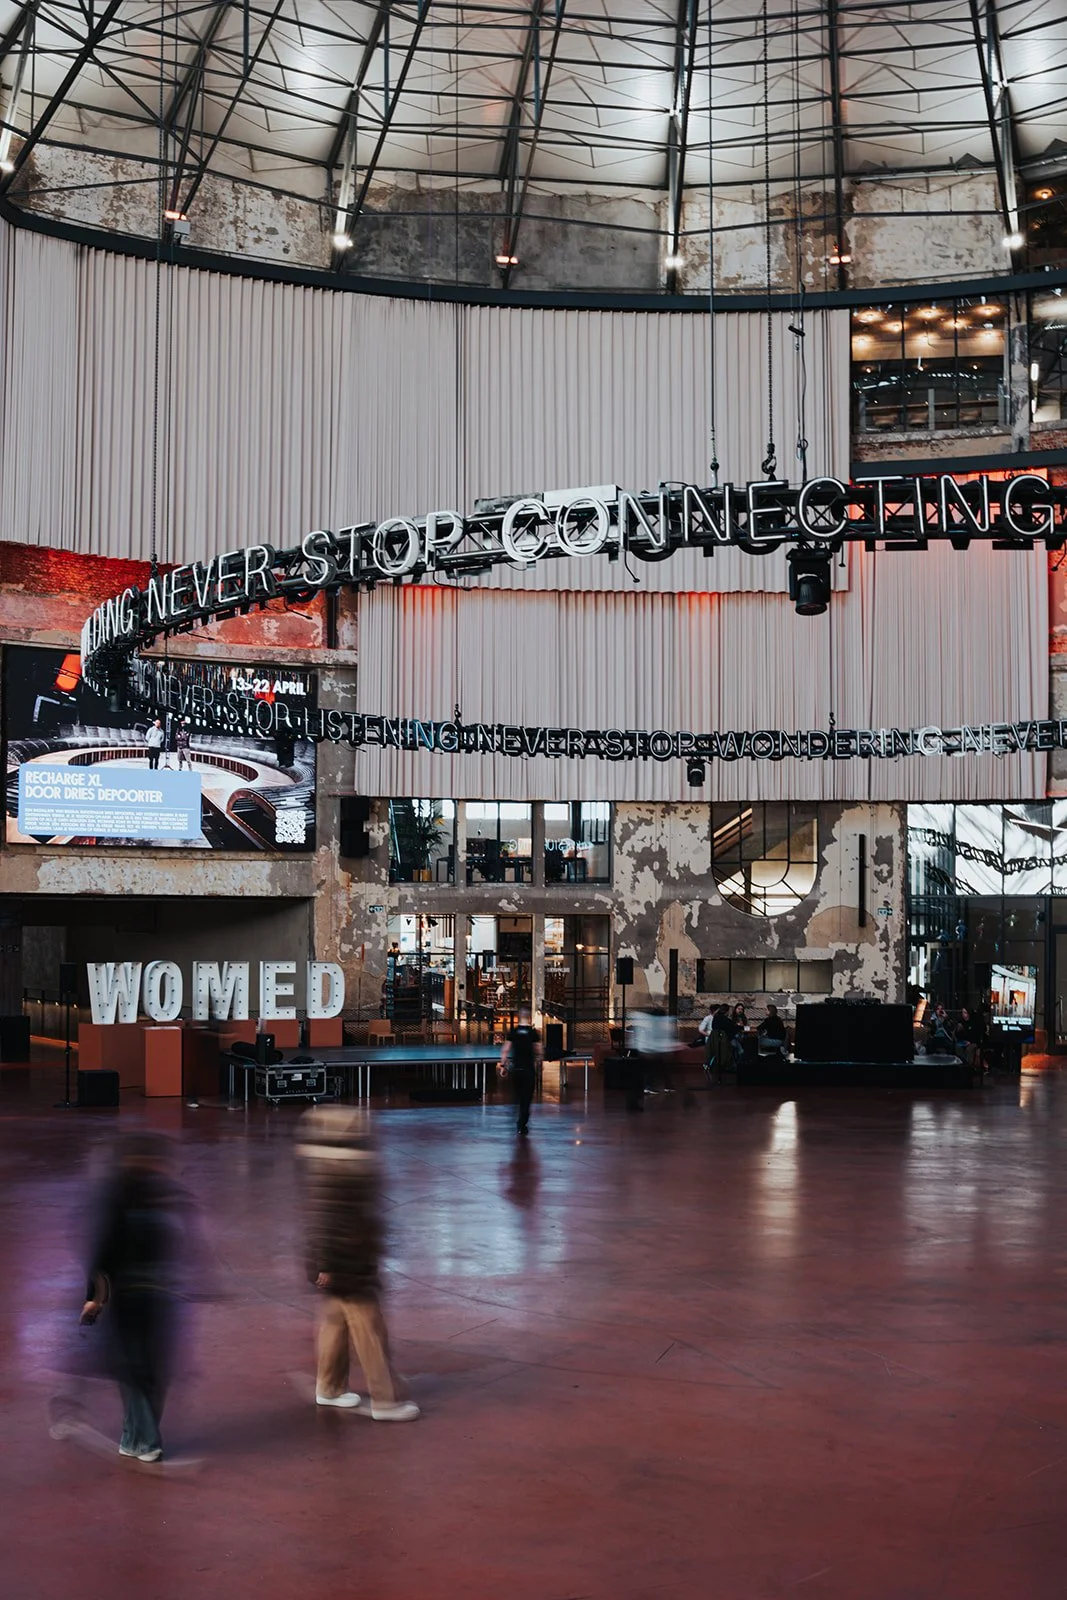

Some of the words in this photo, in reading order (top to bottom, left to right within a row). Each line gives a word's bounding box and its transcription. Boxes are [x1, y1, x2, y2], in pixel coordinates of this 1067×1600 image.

[148, 545, 270, 624] NEVER
[303, 510, 464, 586] STOP
[502, 474, 1056, 562] CONNECTING
[272, 680, 307, 696] APRIL
[156, 671, 220, 721] NEVER
[227, 691, 293, 731] STOP
[304, 707, 458, 750] LISTENING
[477, 723, 584, 756] NEVER
[605, 728, 696, 758] STOP
[714, 725, 944, 759] WONDERING
[25, 771, 85, 786] RECHARGE
[88, 773, 102, 787] XL
[25, 785, 61, 800] DOOR
[64, 787, 95, 801] DRIES
[98, 788, 163, 804] DEPOORTER
[86, 960, 345, 1025] WOMED
